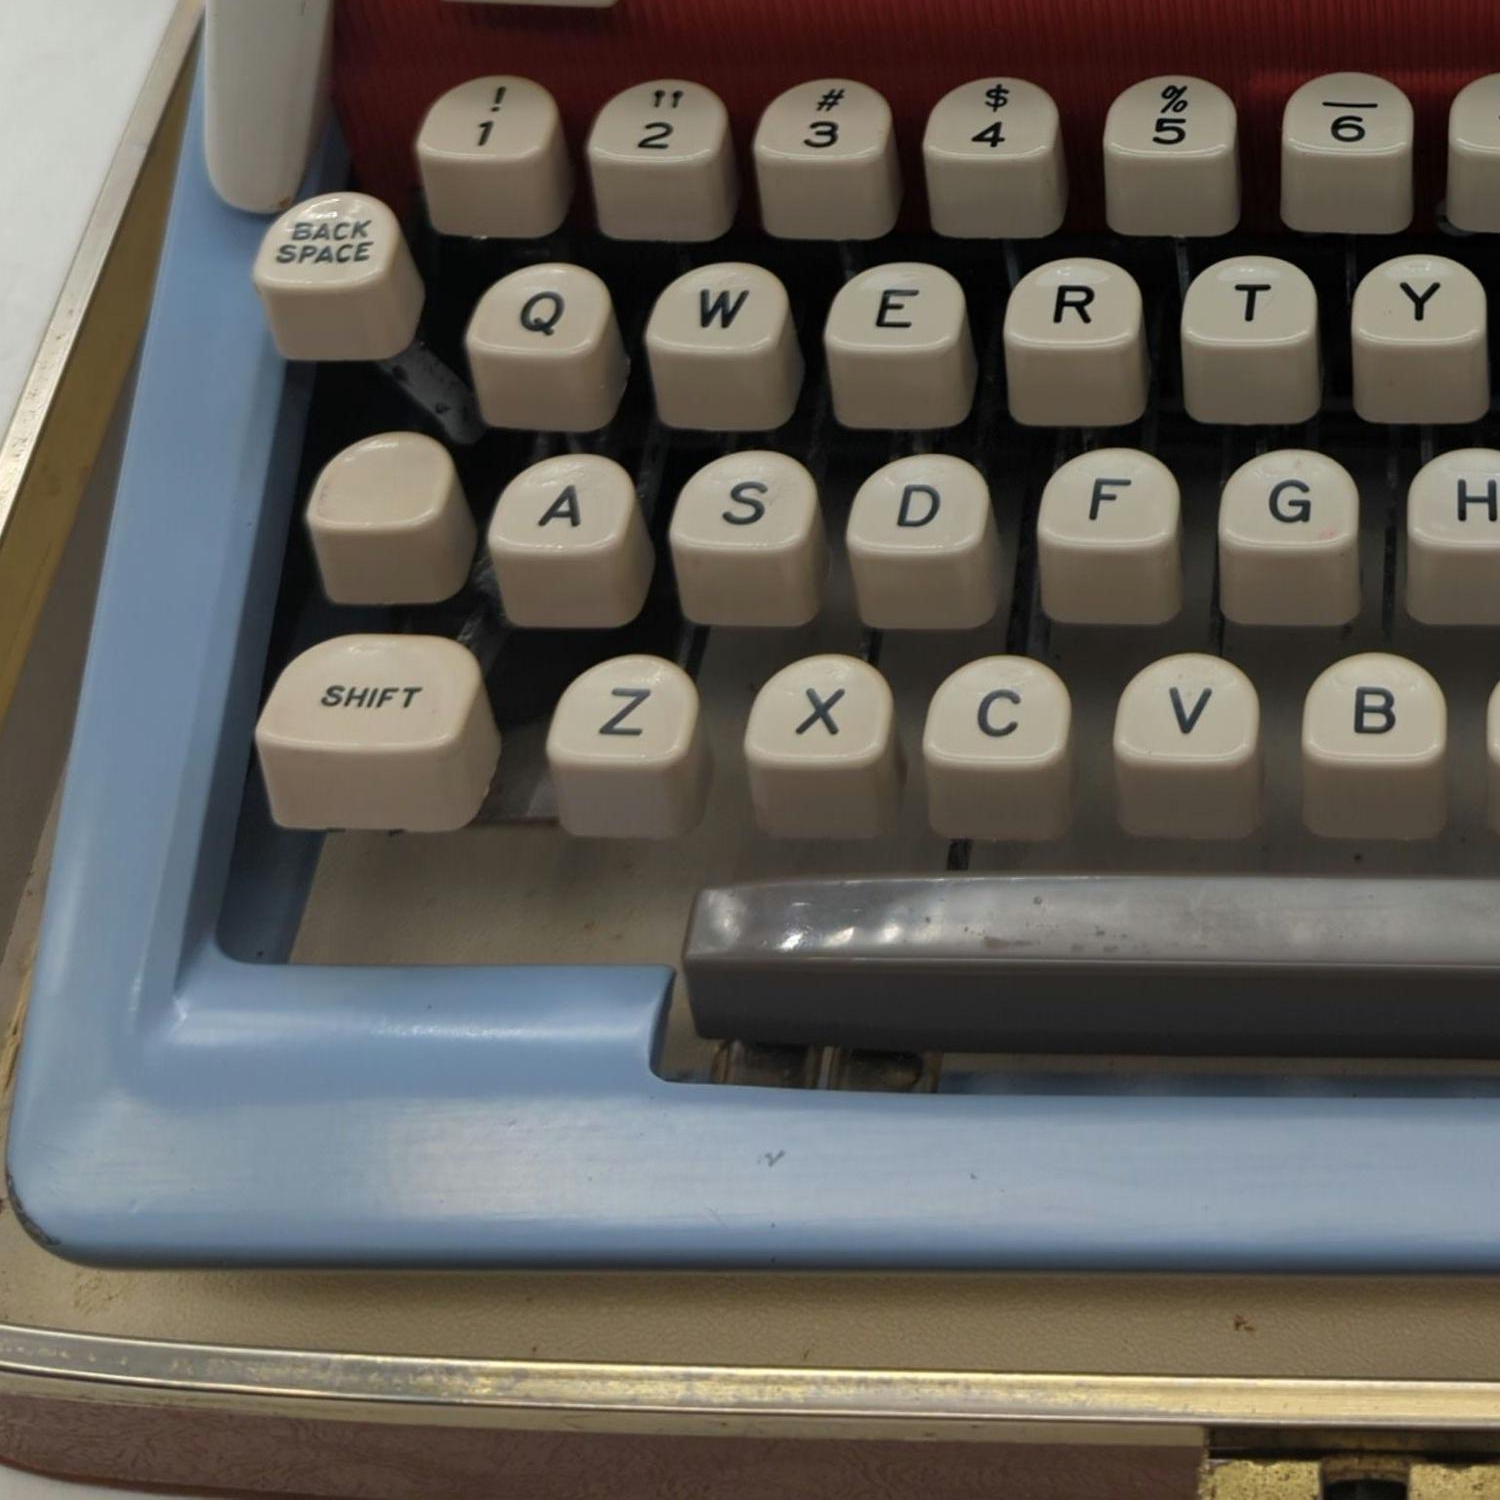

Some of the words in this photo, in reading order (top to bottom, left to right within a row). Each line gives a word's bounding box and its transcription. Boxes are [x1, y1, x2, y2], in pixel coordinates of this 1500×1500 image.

[816, 88, 845, 112] #
[984, 82, 1011, 113] $
[1160, 84, 1189, 114] %
[477, 120, 494, 147] 1
[637, 121, 674, 150] 2
[803, 120, 839, 149] 3
[971, 121, 1006, 148] 4
[1152, 116, 1187, 146] 5
[1330, 115, 1366, 143] 6
[291, 219, 373, 242] BACK
[275, 241, 374, 264] SPACE
[519, 291, 565, 337] Q
[699, 289, 750, 329] W
[875, 289, 920, 329] E
[1052, 284, 1095, 324] R
[1234, 283, 1272, 322] T
[1399, 282, 1441, 322] Y
[537, 485, 581, 528] A
[721, 481, 769, 526] S
[896, 485, 941, 528] D
[1088, 478, 1132, 521] F
[1268, 479, 1312, 524] G
[1457, 479, 1498, 523] H
[320, 685, 423, 709] SHIFT
[598, 688, 651, 737] Z
[795, 688, 846, 736] X
[976, 689, 1021, 738] C
[1169, 687, 1213, 735] V
[1353, 686, 1397, 735] B
